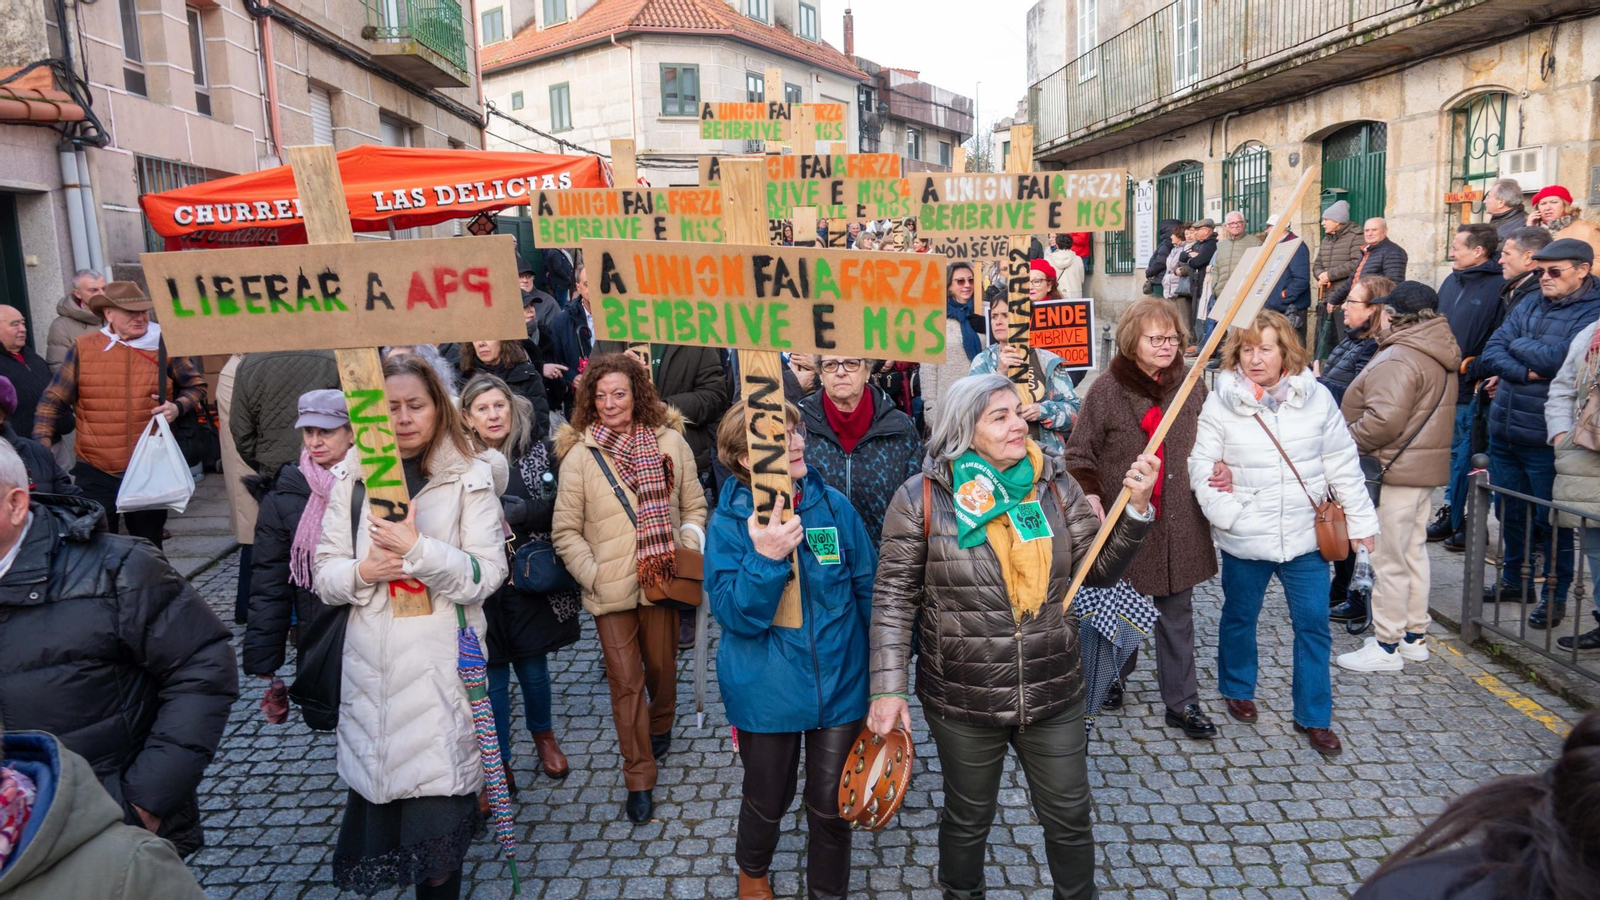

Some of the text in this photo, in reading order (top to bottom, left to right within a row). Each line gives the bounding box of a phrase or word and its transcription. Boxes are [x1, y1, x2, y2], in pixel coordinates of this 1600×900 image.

[702, 102, 714, 120] A
[718, 102, 765, 121] UNION
[702, 120, 782, 140] BEMBRIVE
[801, 154, 831, 179] FAI
[848, 153, 899, 178] FORZA
[174, 171, 572, 226] CHURRE LAS DELICIAS
[538, 192, 553, 216] A
[557, 191, 620, 217] UNION
[622, 191, 653, 215] FAI
[668, 189, 722, 216] FORZA
[831, 180, 843, 206] E
[858, 178, 899, 206] MOS
[922, 176, 940, 204] A
[944, 177, 1012, 202] UNION
[1017, 174, 1050, 200] FAI
[1066, 172, 1122, 199] FORZA
[538, 215, 725, 244] BEMBRIVE E MOS
[920, 200, 1123, 232] BEMBRIVE E MOS
[935, 240, 1009, 259] NON SE VE
[165, 268, 348, 317] LIBERAR
[365, 272, 395, 311] A
[600, 251, 947, 306] A UNION FAI A FORZA
[601, 297, 945, 355] BEMBRIVE E MOS
[344, 388, 402, 489] NON
[746, 374, 788, 475] NON
[808, 532, 836, 544] NON
